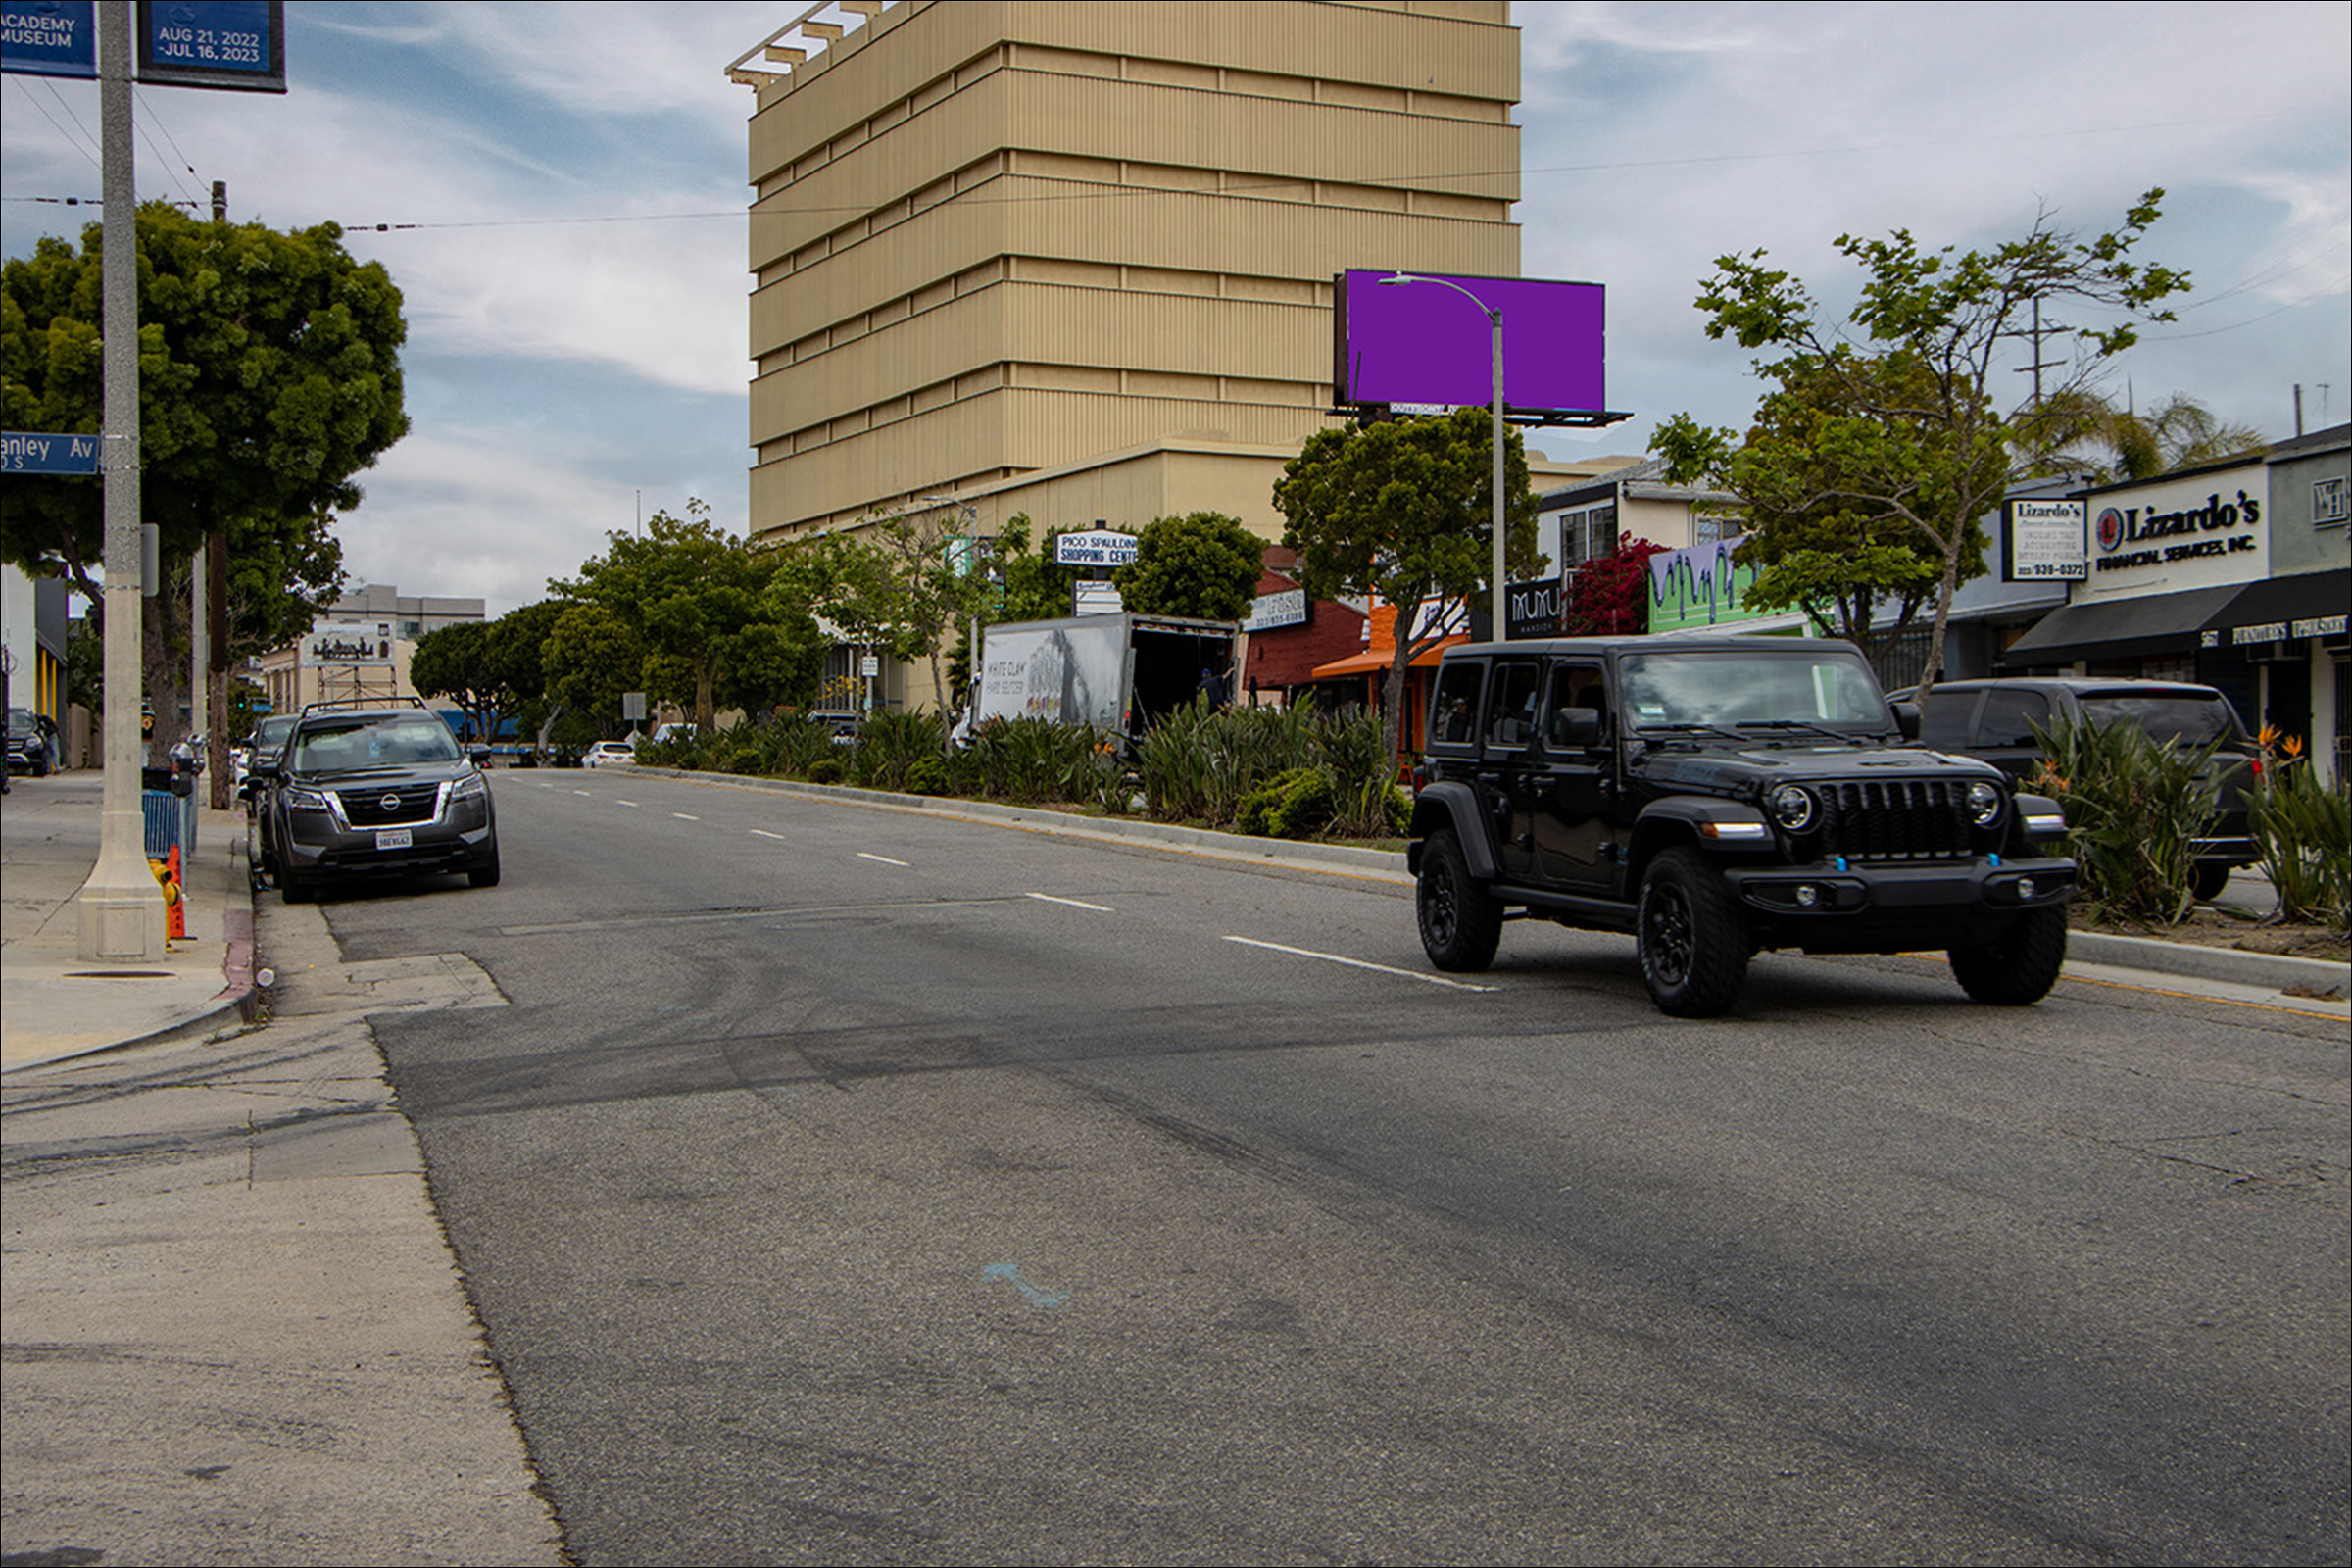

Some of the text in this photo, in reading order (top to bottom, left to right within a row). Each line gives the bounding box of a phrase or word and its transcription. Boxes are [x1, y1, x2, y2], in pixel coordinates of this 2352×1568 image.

[1, 28, 72, 48] MUSEUM
[159, 27, 260, 47] AUG 21, 2022
[197, 45, 219, 60] 16,
[221, 46, 260, 63] 2023
[70, 438, 93, 458] Av
[14, 455, 24, 469] S
[2018, 503, 2081, 517] Lizardo's
[2125, 489, 2260, 542] Lizardo's
[1062, 536, 1087, 547] PICO
[1060, 549, 1104, 562] SHOPPING
[2096, 550, 2163, 571] FINANCIAL
[2228, 534, 2257, 552] INC.
